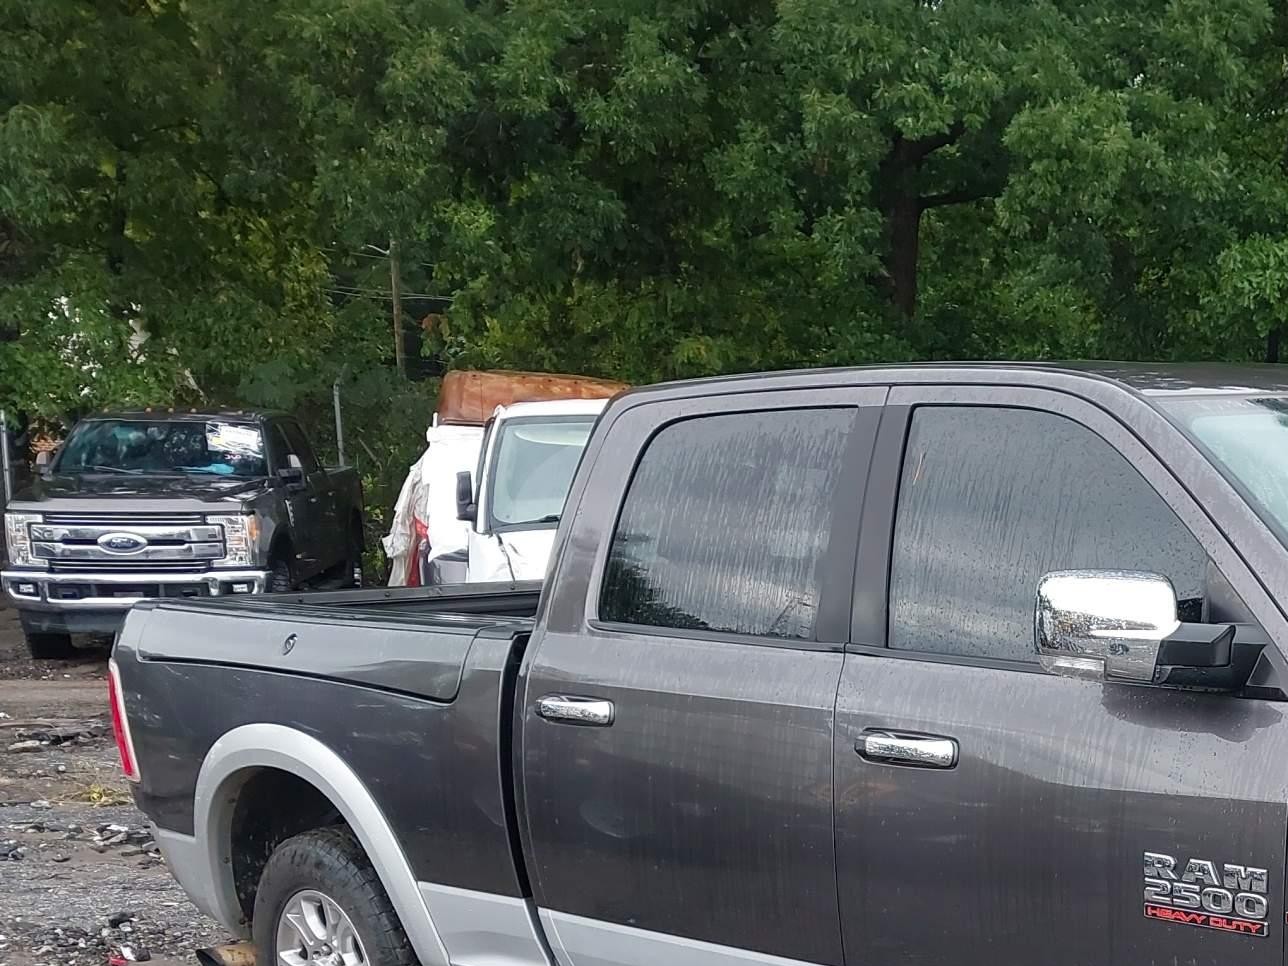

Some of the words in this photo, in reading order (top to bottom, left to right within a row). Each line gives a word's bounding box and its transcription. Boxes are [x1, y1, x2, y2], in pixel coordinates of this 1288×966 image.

[1143, 852, 1269, 893] RAM
[1143, 877, 1269, 919] 2500
[1147, 906, 1207, 924] HEAVY
[1208, 916, 1262, 934] DUTY
